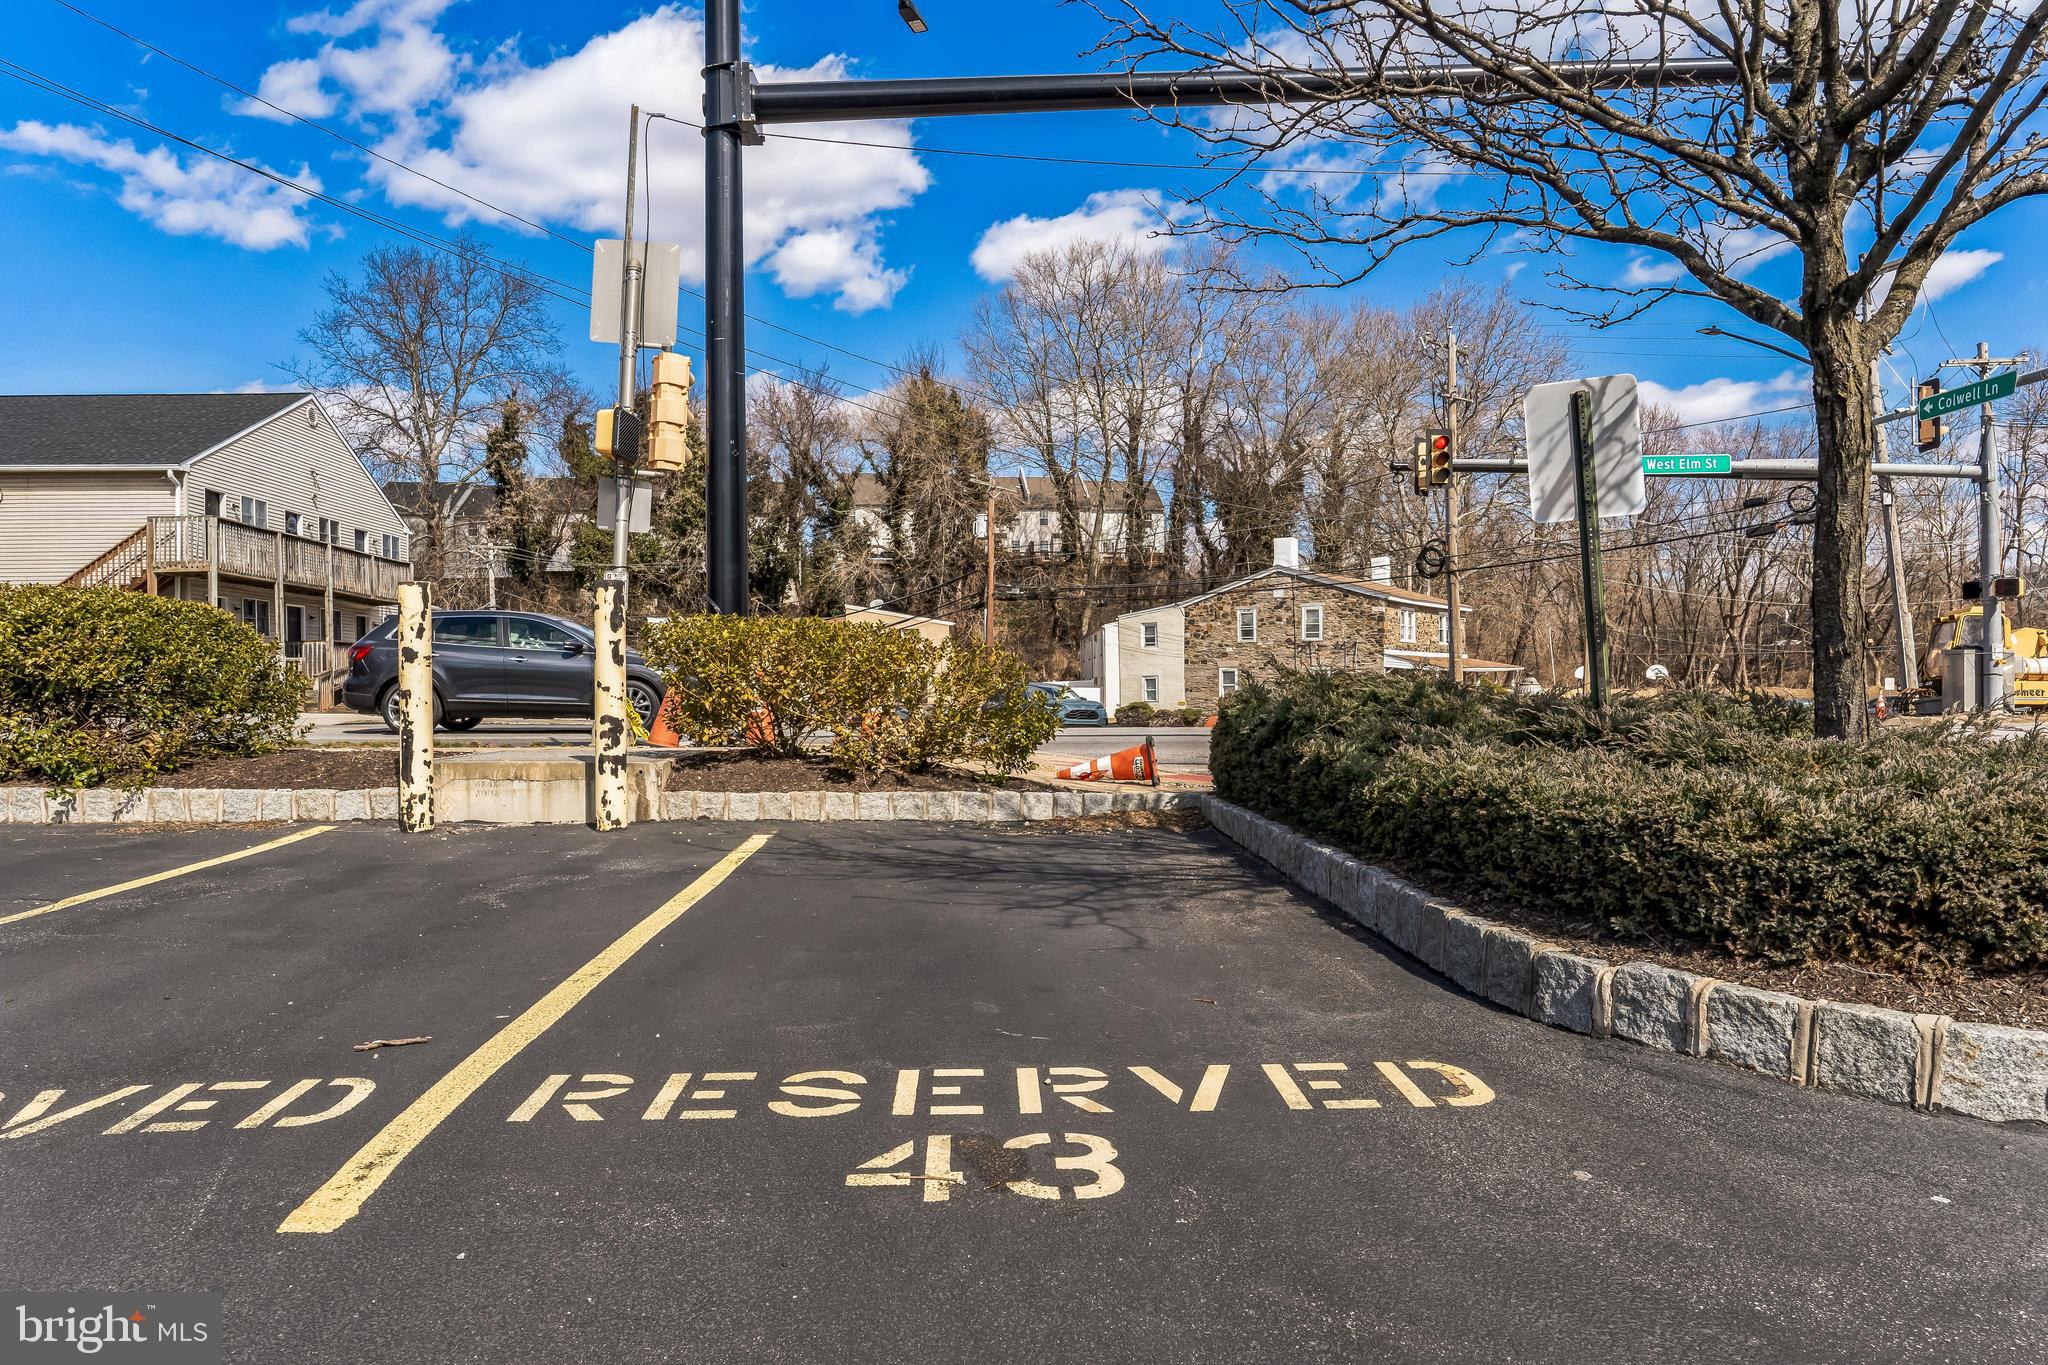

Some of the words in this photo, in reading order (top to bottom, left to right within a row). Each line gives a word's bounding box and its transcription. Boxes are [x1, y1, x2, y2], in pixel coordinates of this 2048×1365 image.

[1938, 387, 1980, 410] Colwell
[1985, 383, 1999, 397] Ln
[1646, 459, 1675, 470] West
[1679, 458, 1701, 469] Elm
[1705, 458, 1718, 469] St
[0, 1077, 376, 1140] VED
[506, 1058, 1496, 1123] RESERVED
[845, 1132, 1126, 1202] 43
